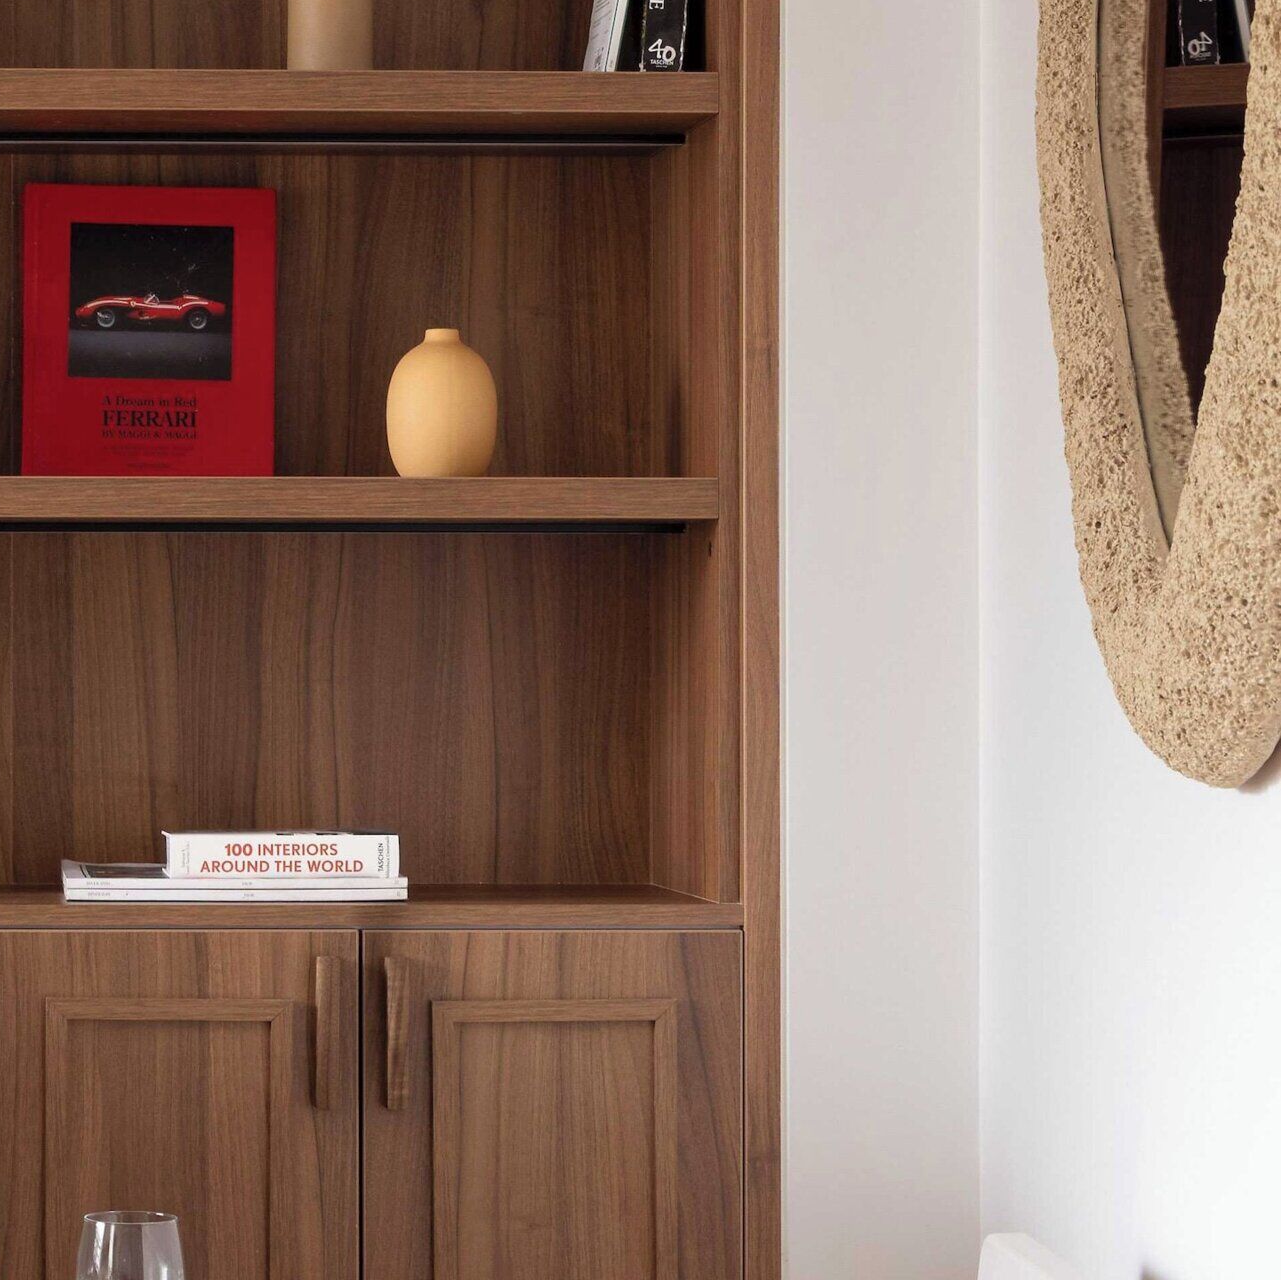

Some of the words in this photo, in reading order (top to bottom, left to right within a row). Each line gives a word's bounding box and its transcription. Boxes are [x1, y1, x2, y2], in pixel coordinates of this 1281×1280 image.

[648, 38, 676, 62] 40
[116, 395, 155, 407] Dream
[174, 396, 197, 407] Red
[102, 410, 198, 428] FERRARI
[224, 843, 253, 857] 100
[258, 843, 338, 857] INTERIORS
[200, 860, 270, 873] AROUND
[274, 860, 303, 873] THE
[307, 860, 364, 873] WORLD
